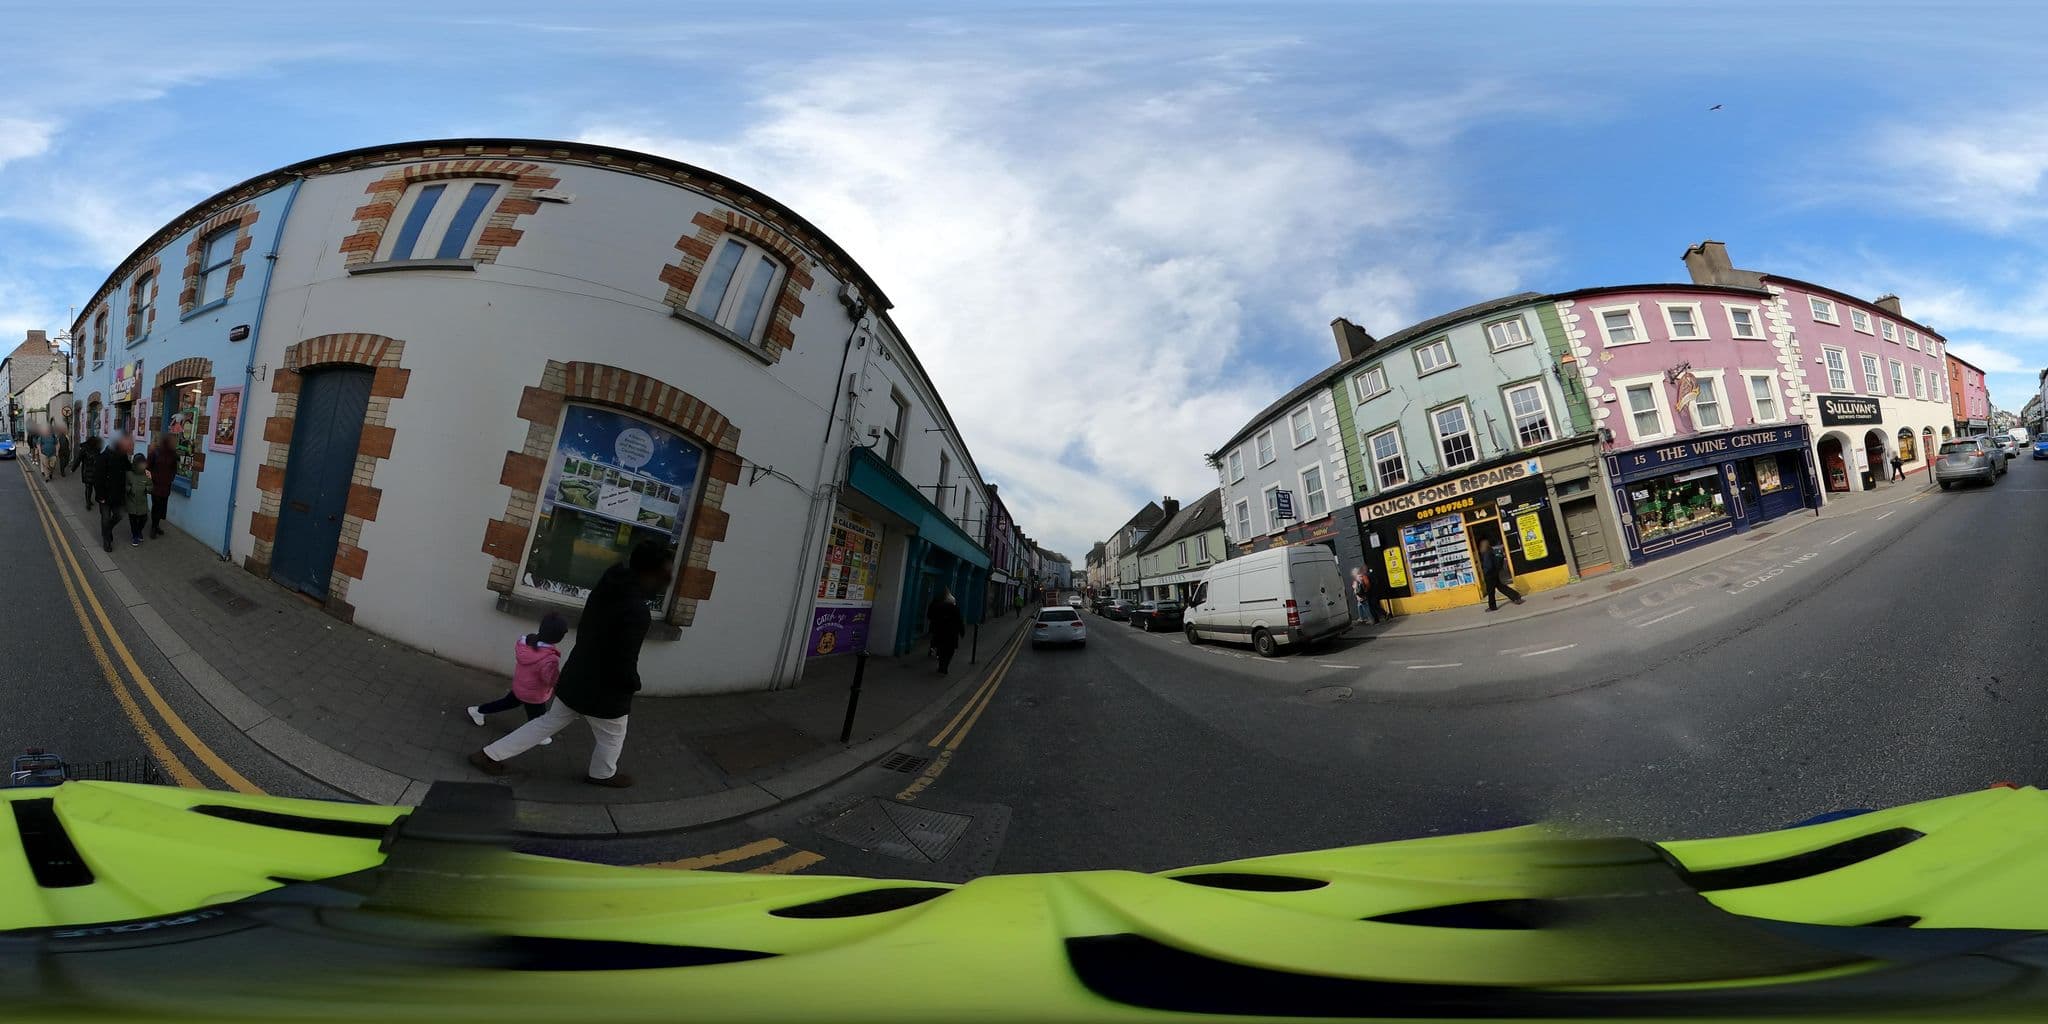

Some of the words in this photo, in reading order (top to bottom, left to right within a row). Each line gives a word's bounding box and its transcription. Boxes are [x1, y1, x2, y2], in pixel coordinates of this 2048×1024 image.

[1826, 400, 1877, 414] SULLIVAN'S
[1634, 455, 1646, 465] 15
[1656, 446, 1688, 462] THE
[1692, 439, 1728, 455] WINE
[1731, 432, 1777, 448] CENTRE
[1784, 431, 1792, 439] 15
[1373, 495, 1415, 516] QUICK
[1418, 483, 1457, 504] FONE
[1460, 464, 1525, 493] REPAIRS
[1417, 508, 1433, 520] 089
[1435, 498, 1474, 515] 9897685
[1474, 509, 1487, 519] 14
[1726, 552, 1819, 595] LOADING
